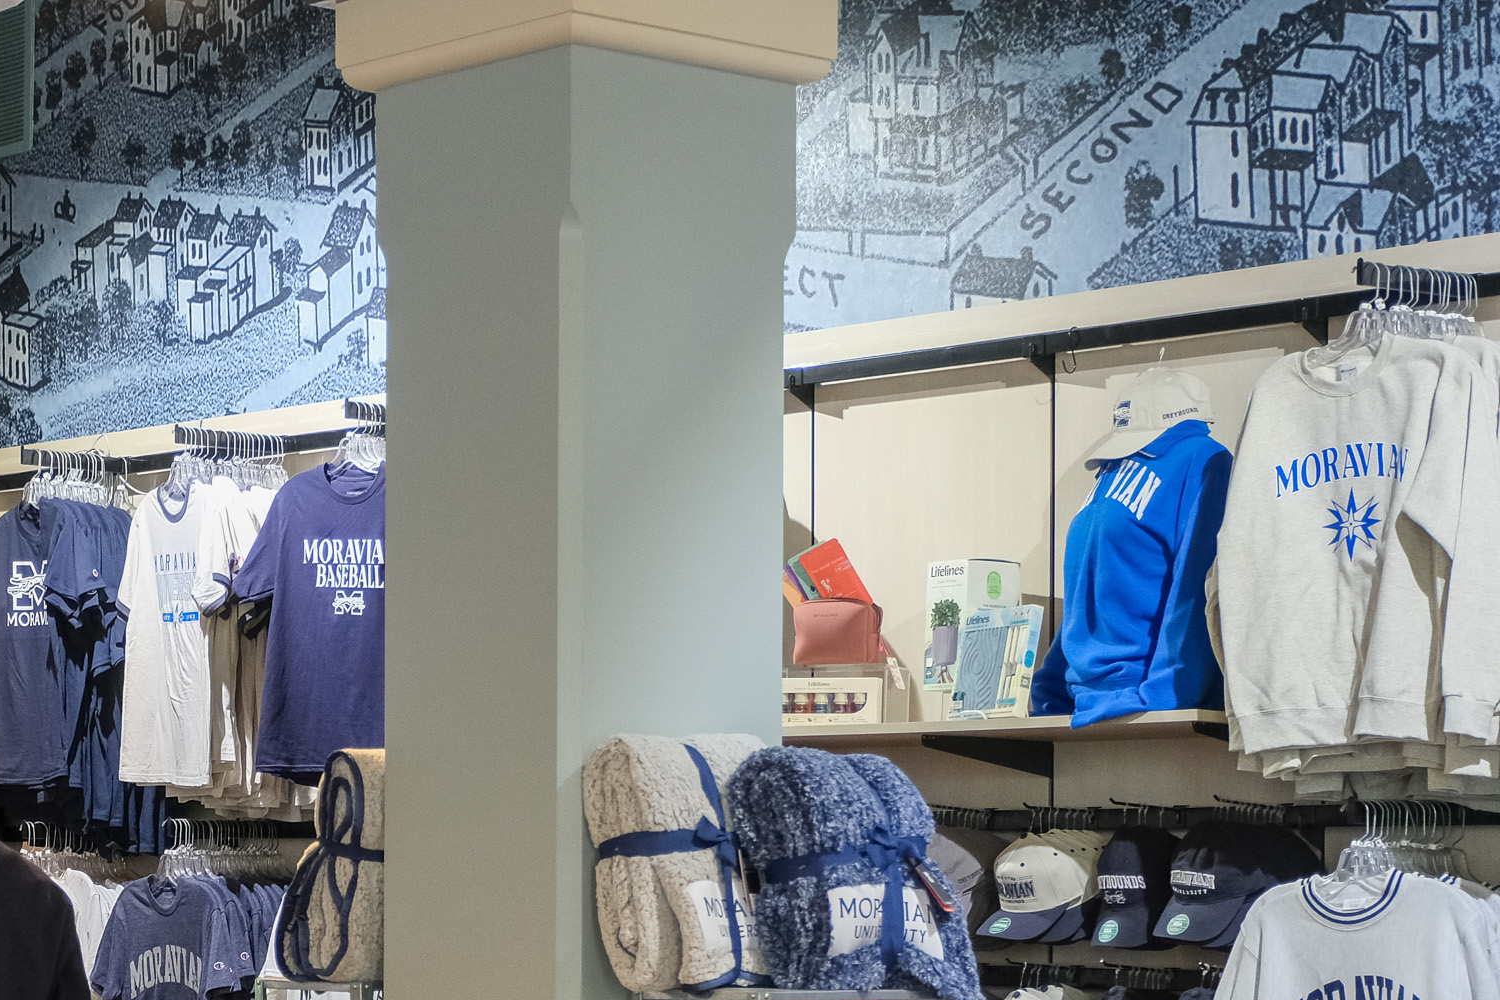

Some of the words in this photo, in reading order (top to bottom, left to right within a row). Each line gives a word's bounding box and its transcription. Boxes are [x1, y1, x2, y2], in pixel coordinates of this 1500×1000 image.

[1020, 81, 1184, 240] SECOND
[1275, 442, 1409, 499] MORAVIAN
[302, 539, 385, 565] MORAVIA
[315, 564, 385, 589] BASEBALL
[930, 565, 965, 578] Lifelines
